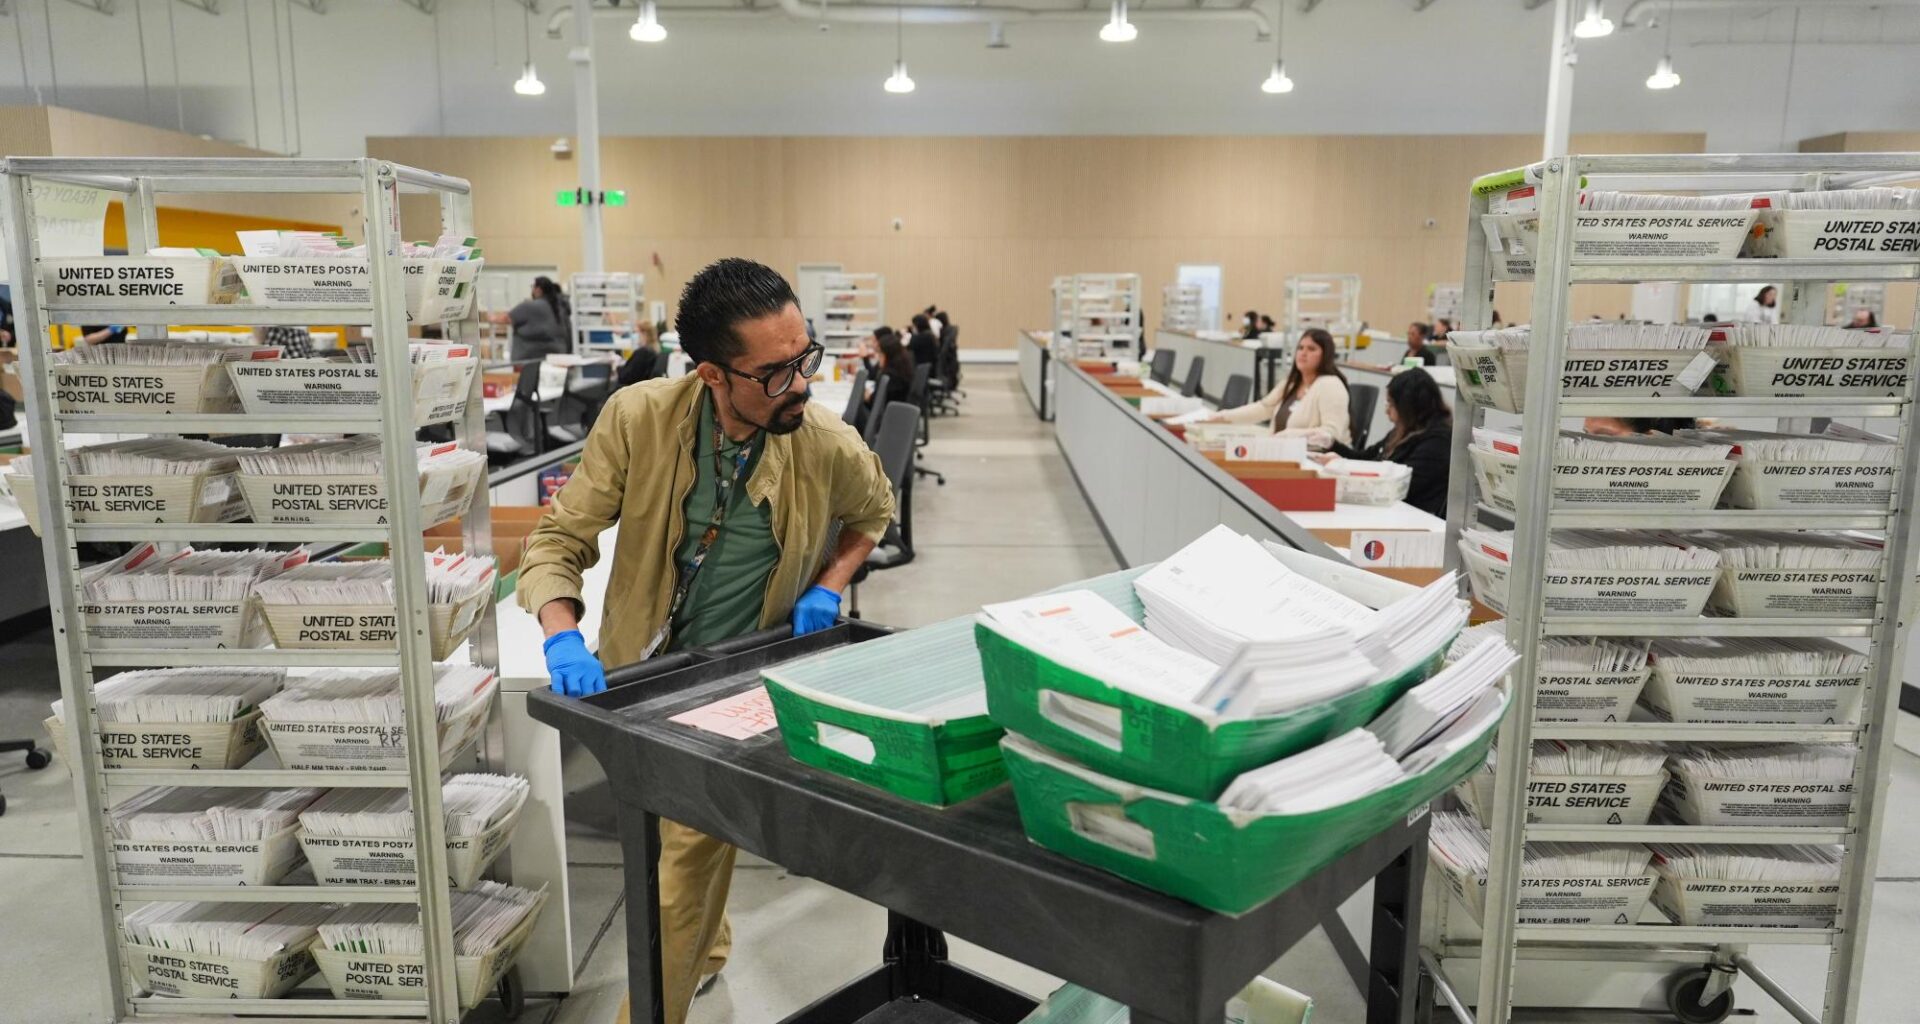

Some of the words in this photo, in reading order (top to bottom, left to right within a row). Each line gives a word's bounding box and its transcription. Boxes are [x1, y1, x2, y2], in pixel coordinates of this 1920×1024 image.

[1576, 217, 1598, 228] TED
[1604, 217, 1647, 228] STATES
[1650, 217, 1693, 228] POSTAL
[1696, 217, 1746, 228] SERVICE
[1824, 220, 1884, 234] UNITED
[1628, 232, 1669, 240] WARNING
[1813, 237, 1876, 251] POSTAL
[1880, 238, 1920, 251] SERV
[59, 267, 114, 280] UNITED
[118, 267, 174, 279] STATES
[242, 264, 280, 274] UNITED
[283, 265, 326, 275] STATES
[328, 265, 369, 275] POSTA
[56, 284, 115, 297] POSTAL
[119, 283, 184, 296] SERVICE
[1608, 359, 1669, 371] STATES
[1782, 358, 1844, 371] UNITED
[1846, 358, 1907, 370] STATES
[237, 367, 272, 377] UNITED
[275, 368, 316, 378] STATES
[318, 369, 361, 378] POSTAL
[58, 375, 108, 388] UNITED
[112, 376, 164, 389] STATES
[1563, 375, 1600, 388] STAL
[1603, 374, 1674, 388] SERVICE
[1771, 373, 1835, 386] POSTAL
[1839, 374, 1907, 387] SERVICE
[57, 391, 110, 404] POSTAL
[114, 392, 176, 404] SERVICE
[1557, 465, 1579, 475] TED
[1581, 466, 1626, 476] STATES
[1628, 466, 1674, 476] POSTAL
[1677, 466, 1725, 476] SERVICE
[1763, 466, 1807, 475] UNITED
[1808, 466, 1852, 476] STATES
[1854, 466, 1894, 476] POSTA
[273, 483, 322, 496] UNITED
[327, 484, 378, 496] STATES
[1609, 480, 1649, 488] WARNING
[69, 485, 98, 497] TED
[102, 485, 153, 497] STATES
[69, 500, 100, 512] STAL
[105, 500, 166, 512] SERVICE
[272, 499, 324, 511] POSTAL
[329, 498, 388, 510] SERVICE
[1546, 575, 1568, 585] TED
[1570, 576, 1614, 586] STATES
[1617, 576, 1661, 586] POSTAL
[1664, 576, 1712, 586] SERVICE
[1738, 572, 1781, 582] UNITED
[1783, 573, 1828, 583] STATES
[1830, 573, 1876, 583] POSTAL
[83, 605, 102, 615] TED
[105, 606, 145, 615] STATES
[148, 606, 190, 615] POSTAL
[193, 605, 239, 614] SERVICE
[303, 616, 354, 627] UNITED
[300, 630, 355, 641] POSTAL
[359, 630, 397, 641] SERV
[1550, 676, 1592, 685] POSTAL
[1595, 676, 1641, 685] SERVICE
[1675, 675, 1719, 686] UNITED
[1720, 677, 1765, 688] STATES
[1767, 678, 1812, 688] POSTAL
[1815, 677, 1861, 688] SERVICE
[269, 722, 305, 733] UNITED
[307, 724, 346, 734] STATES
[348, 725, 386, 735] POSTAL
[101, 733, 137, 744] NITED
[141, 734, 191, 745] STATES
[103, 748, 138, 759] STAL
[143, 748, 202, 758] SERVICE
[1569, 783, 1626, 794] STATES
[1704, 782, 1746, 792] UNITED
[1747, 784, 1790, 793] STATES
[1793, 784, 1835, 793] POSTAL
[1528, 797, 1561, 808] STAL
[1564, 796, 1631, 808] SERVICE
[114, 844, 130, 852] TED
[132, 844, 170, 853] STATES
[172, 844, 211, 853] POSTAL
[215, 844, 259, 853] SERVICE
[304, 838, 340, 847] UNITED
[342, 839, 380, 848] STATES
[445, 841, 469, 849] VICE
[1521, 879, 1560, 888] STATES
[1562, 879, 1602, 888] POSTAL
[1606, 877, 1650, 887] SERVICE
[1686, 884, 1727, 893] UNITED
[1729, 885, 1770, 894] STATES
[1773, 885, 1814, 894] POSTAL
[147, 954, 186, 969] UNITED
[189, 961, 229, 975] STATES
[347, 961, 393, 974] UNITED
[396, 963, 424, 975] STAT
[148, 966, 189, 981] POSTAL
[192, 973, 239, 989] SERVICE
[346, 973, 394, 986] POSTAL
